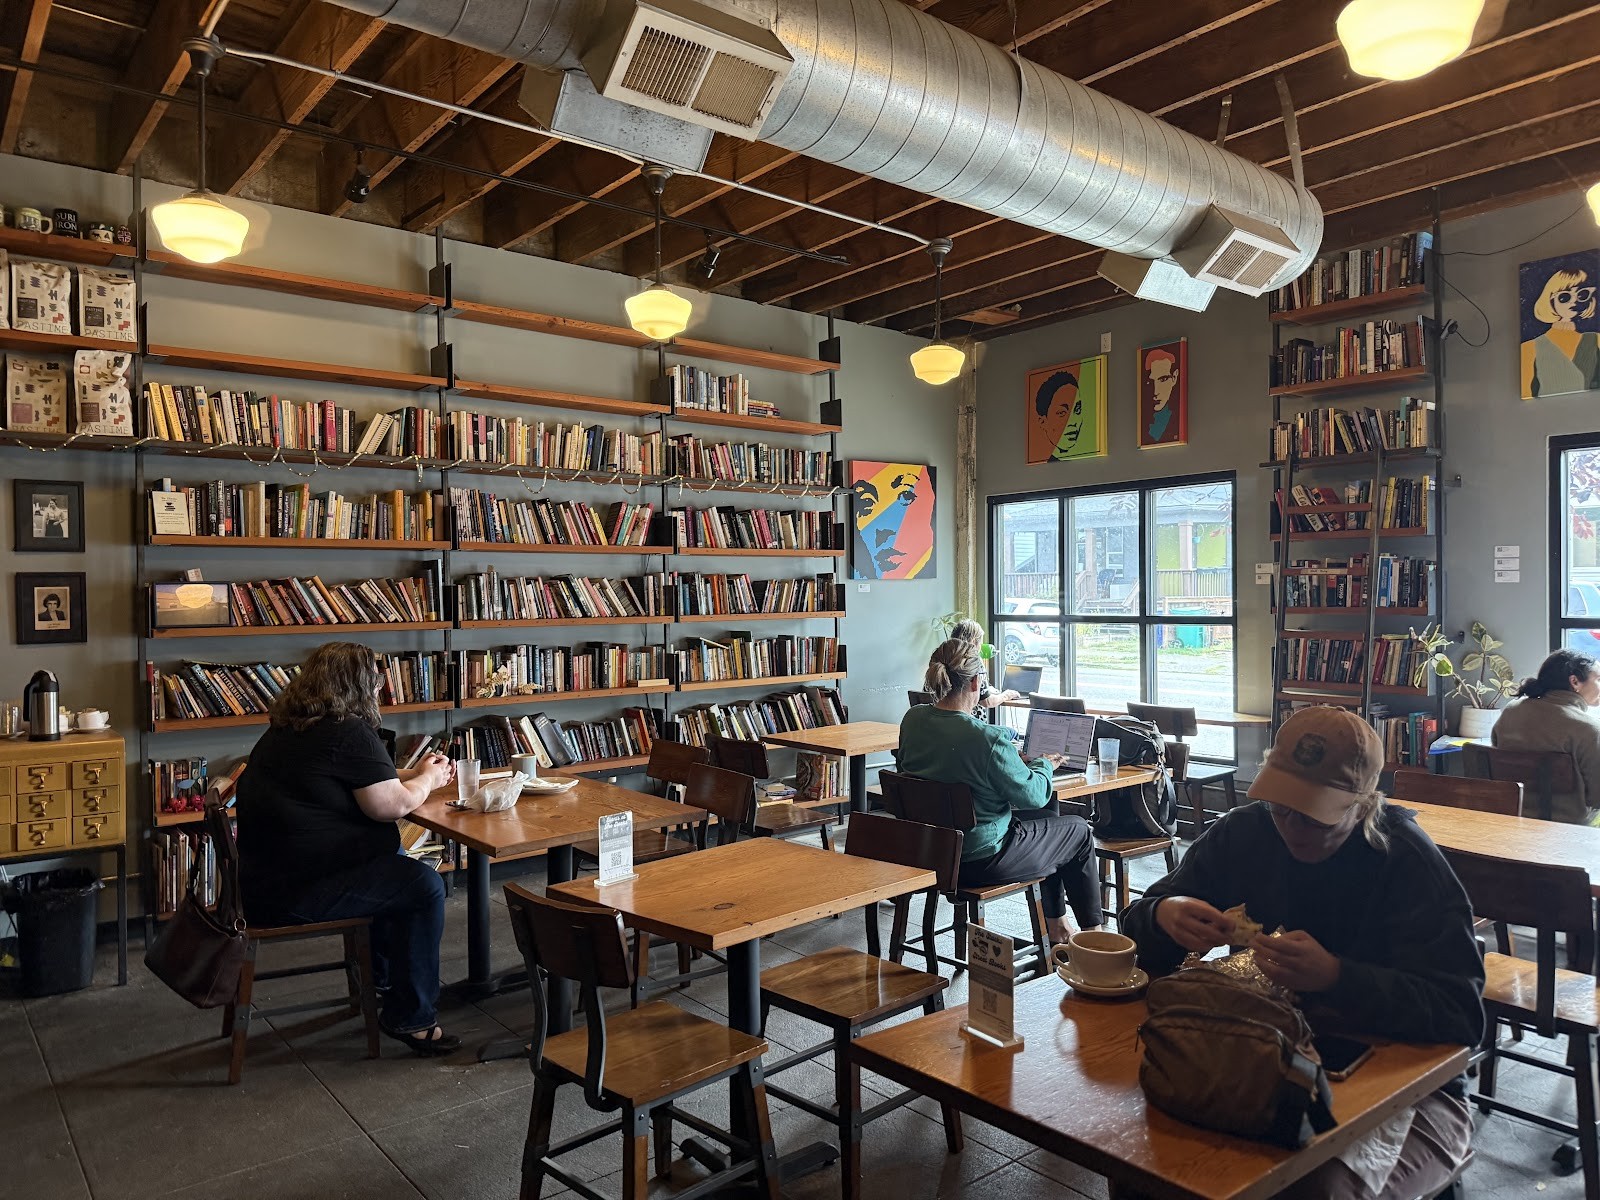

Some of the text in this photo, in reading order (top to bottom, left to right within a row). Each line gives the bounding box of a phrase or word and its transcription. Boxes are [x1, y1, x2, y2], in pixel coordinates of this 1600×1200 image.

[16, 320, 69, 334] PASTIME
[84, 328, 135, 342] PASTIME
[80, 424, 130, 435] PASTIME
